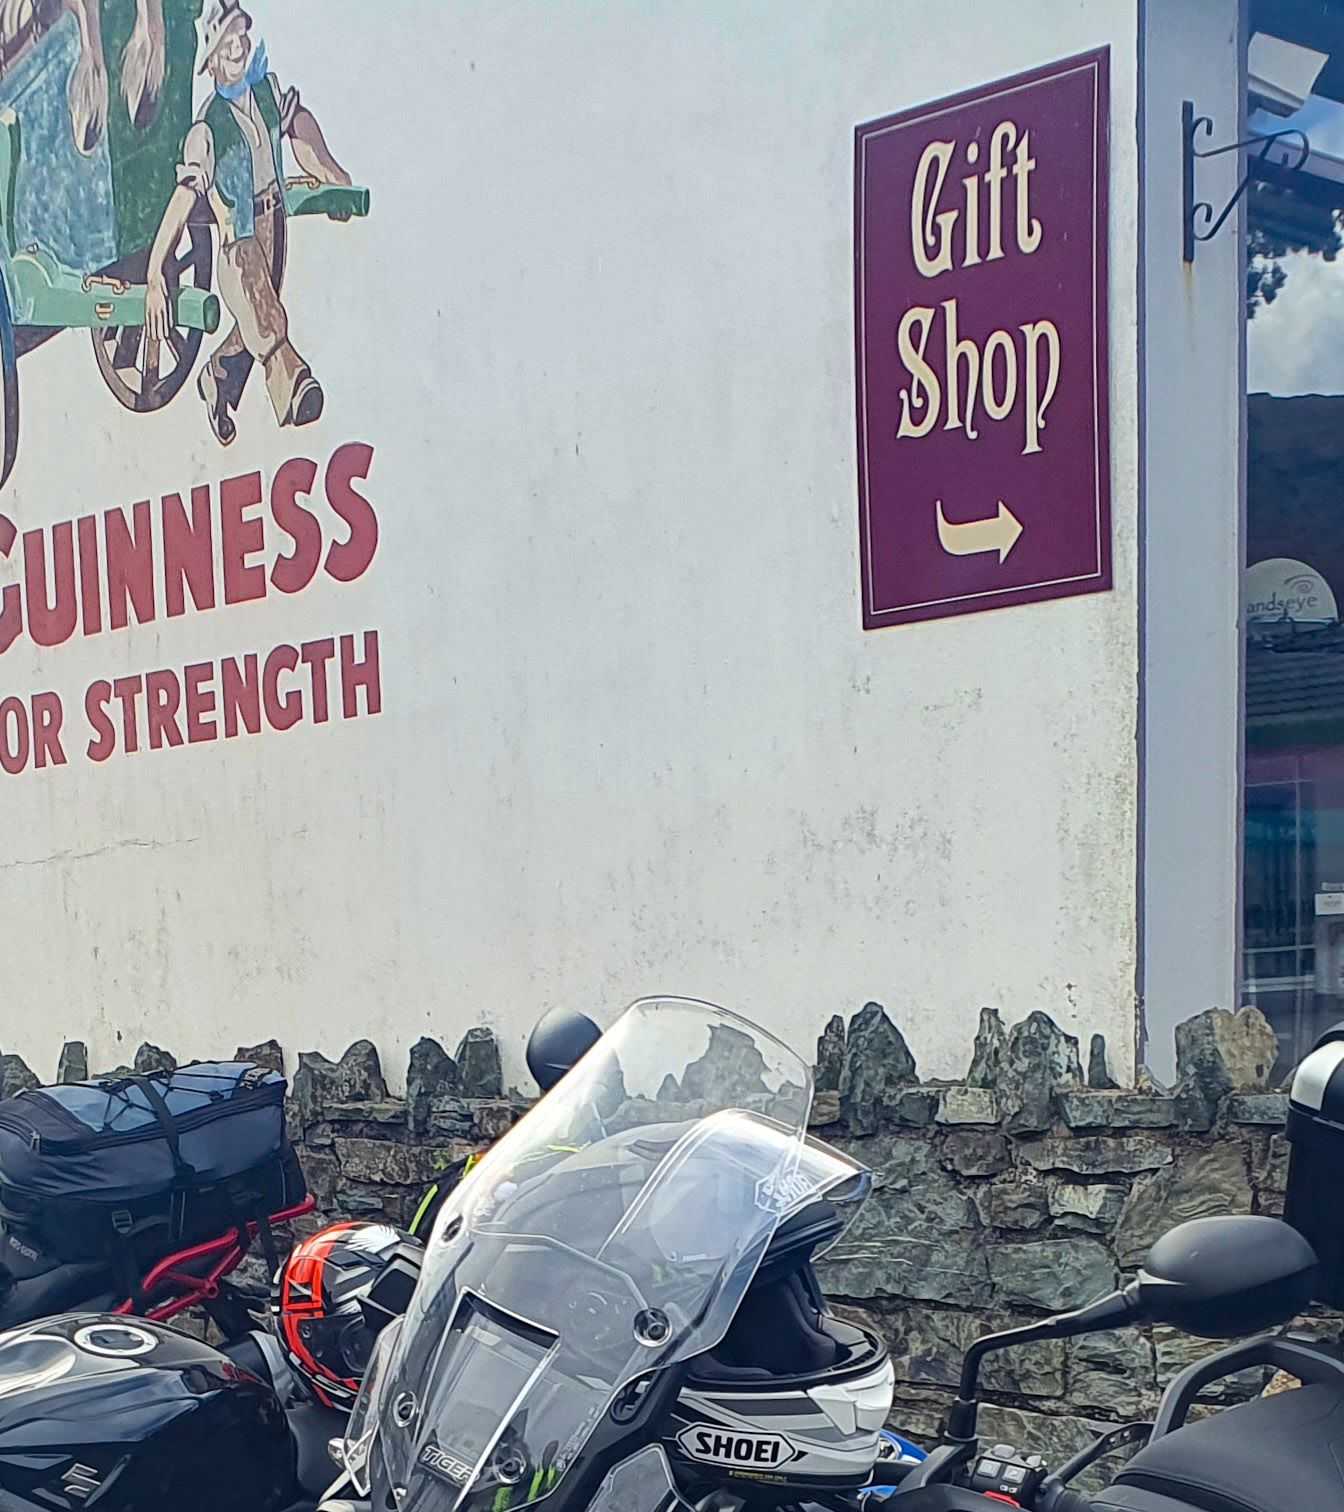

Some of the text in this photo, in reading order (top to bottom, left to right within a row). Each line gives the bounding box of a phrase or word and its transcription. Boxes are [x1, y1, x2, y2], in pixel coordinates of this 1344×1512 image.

[910, 120, 1042, 280] Gift
[896, 297, 1062, 455] Shop
[1246, 592, 1318, 615] andseye
[84, 630, 383, 762] STRENGTH
[695, 1431, 780, 1463] SHOEI
